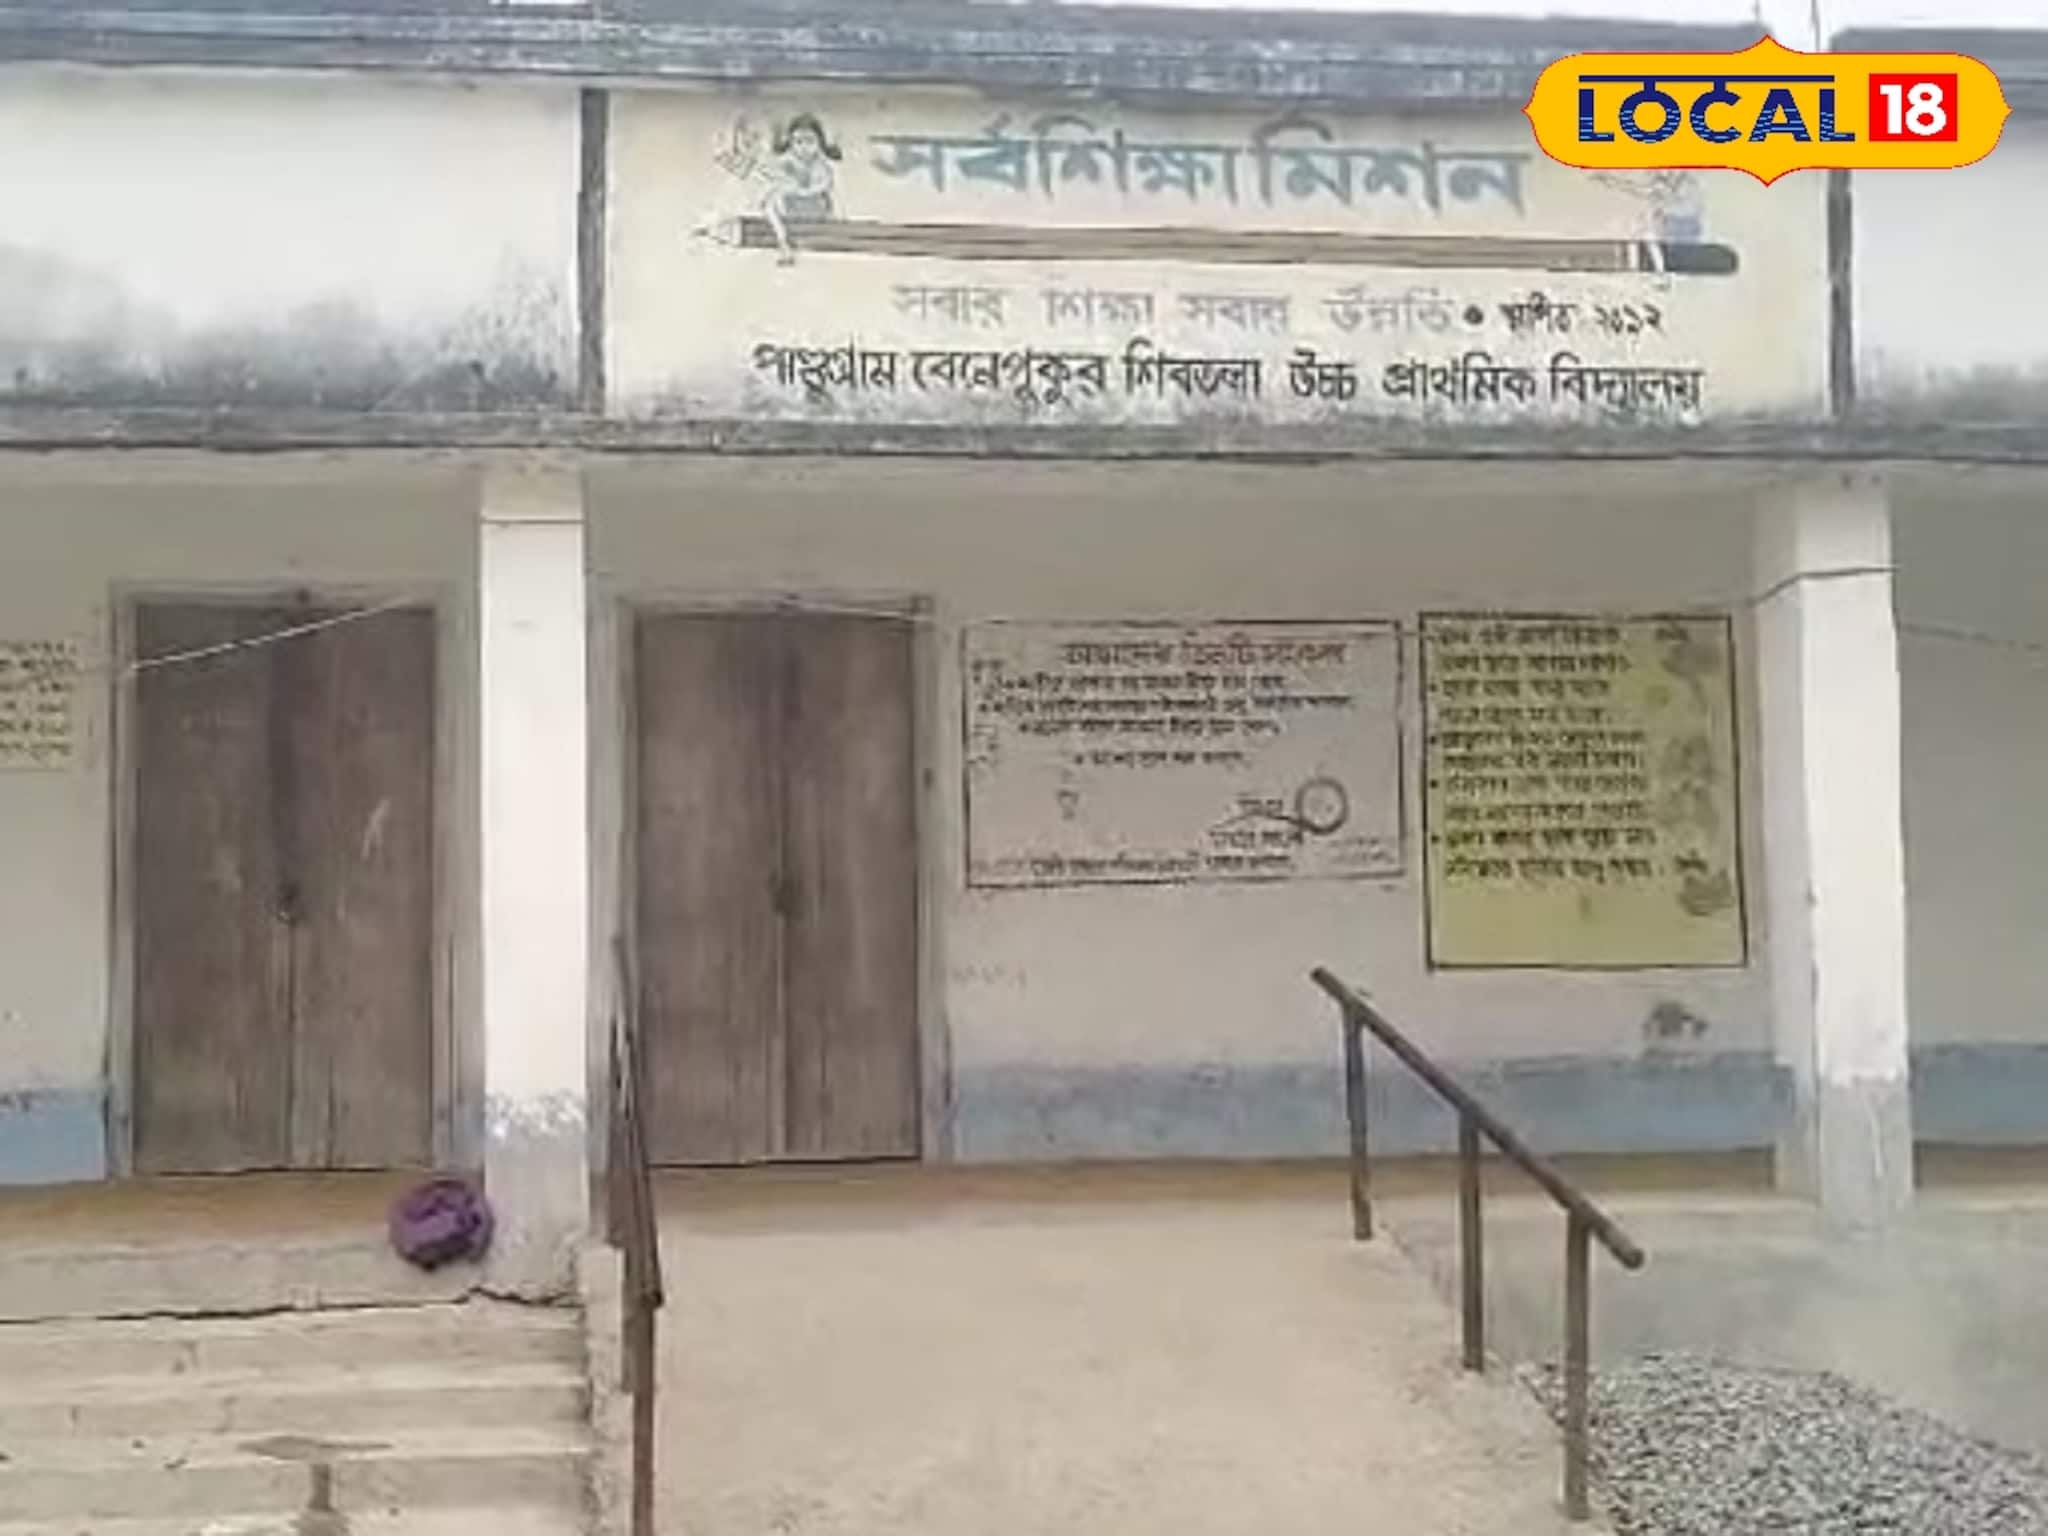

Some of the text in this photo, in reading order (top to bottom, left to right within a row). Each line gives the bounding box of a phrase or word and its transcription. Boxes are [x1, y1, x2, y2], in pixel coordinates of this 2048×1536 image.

[1247, 113, 1533, 216] মিশন
[890, 283, 1010, 329] সবার
[1177, 290, 1291, 335] সবার
[1288, 346, 1357, 400] উচ্চ
[1381, 350, 1536, 405] প্রাথমিক
